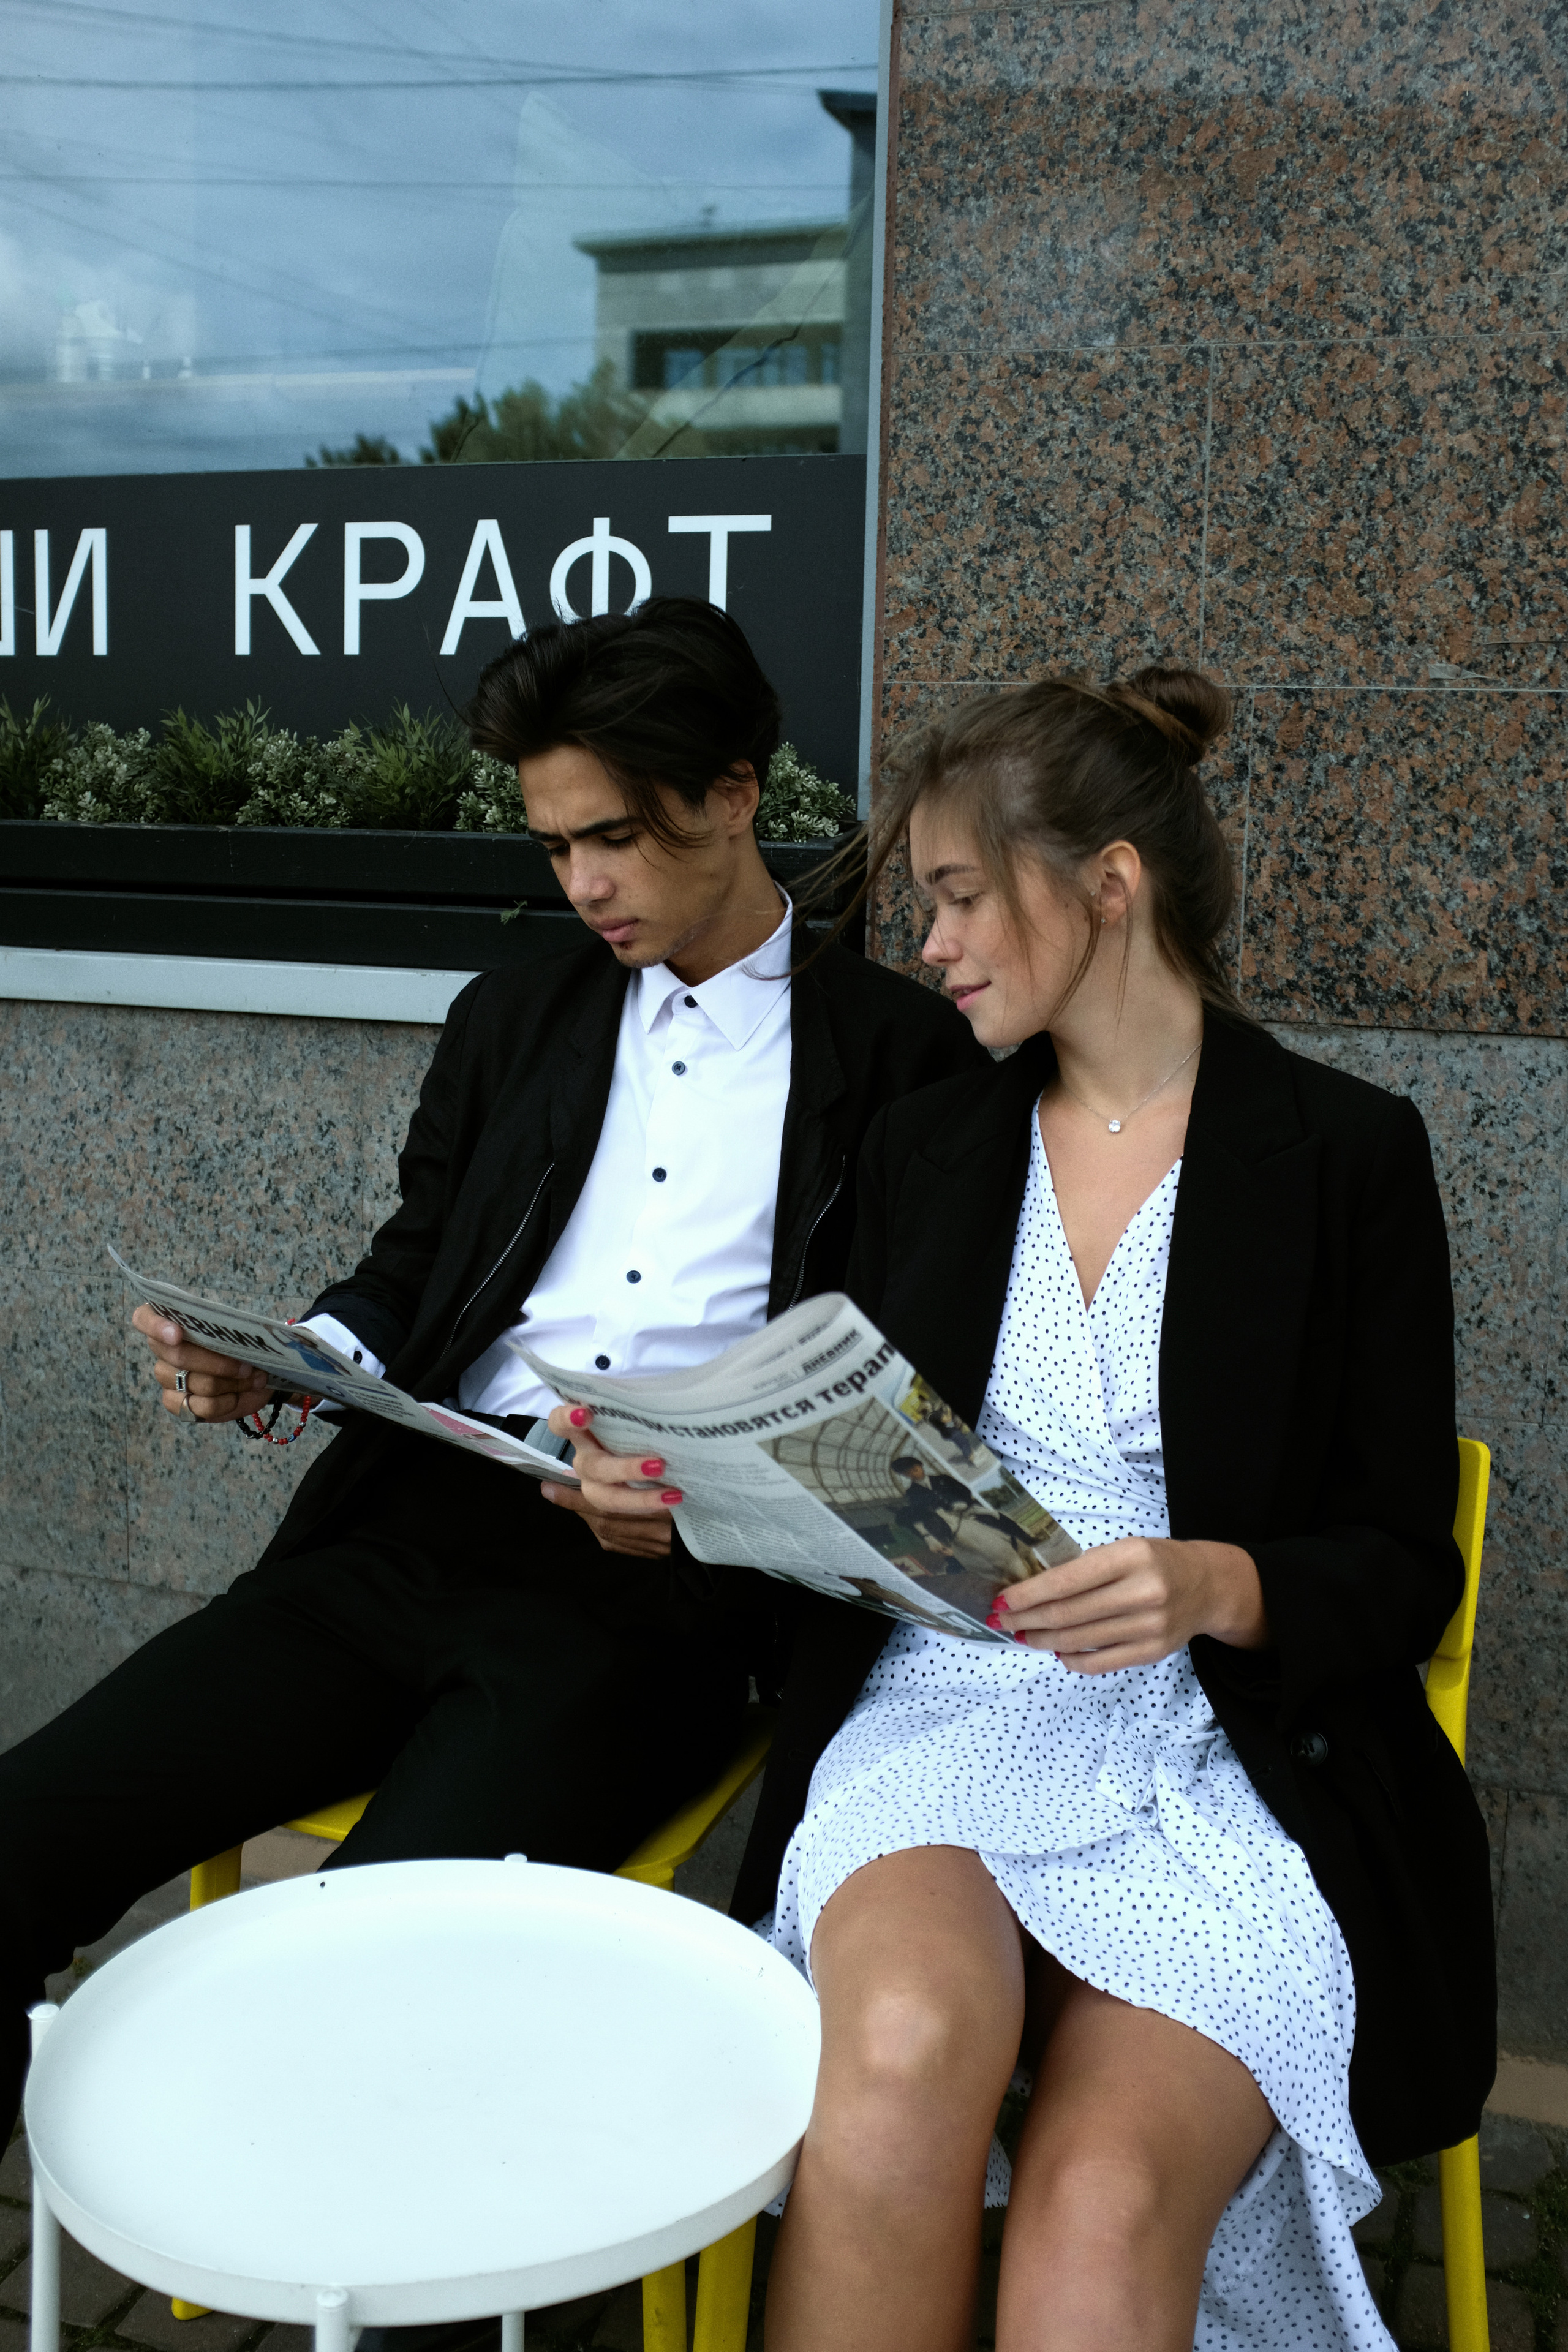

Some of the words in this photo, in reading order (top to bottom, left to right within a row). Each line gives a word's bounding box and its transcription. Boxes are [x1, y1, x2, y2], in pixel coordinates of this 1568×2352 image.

[0, 527, 107, 656] И
[235, 514, 772, 656] КРАФТ
[668, 1399, 816, 1439] становятся
